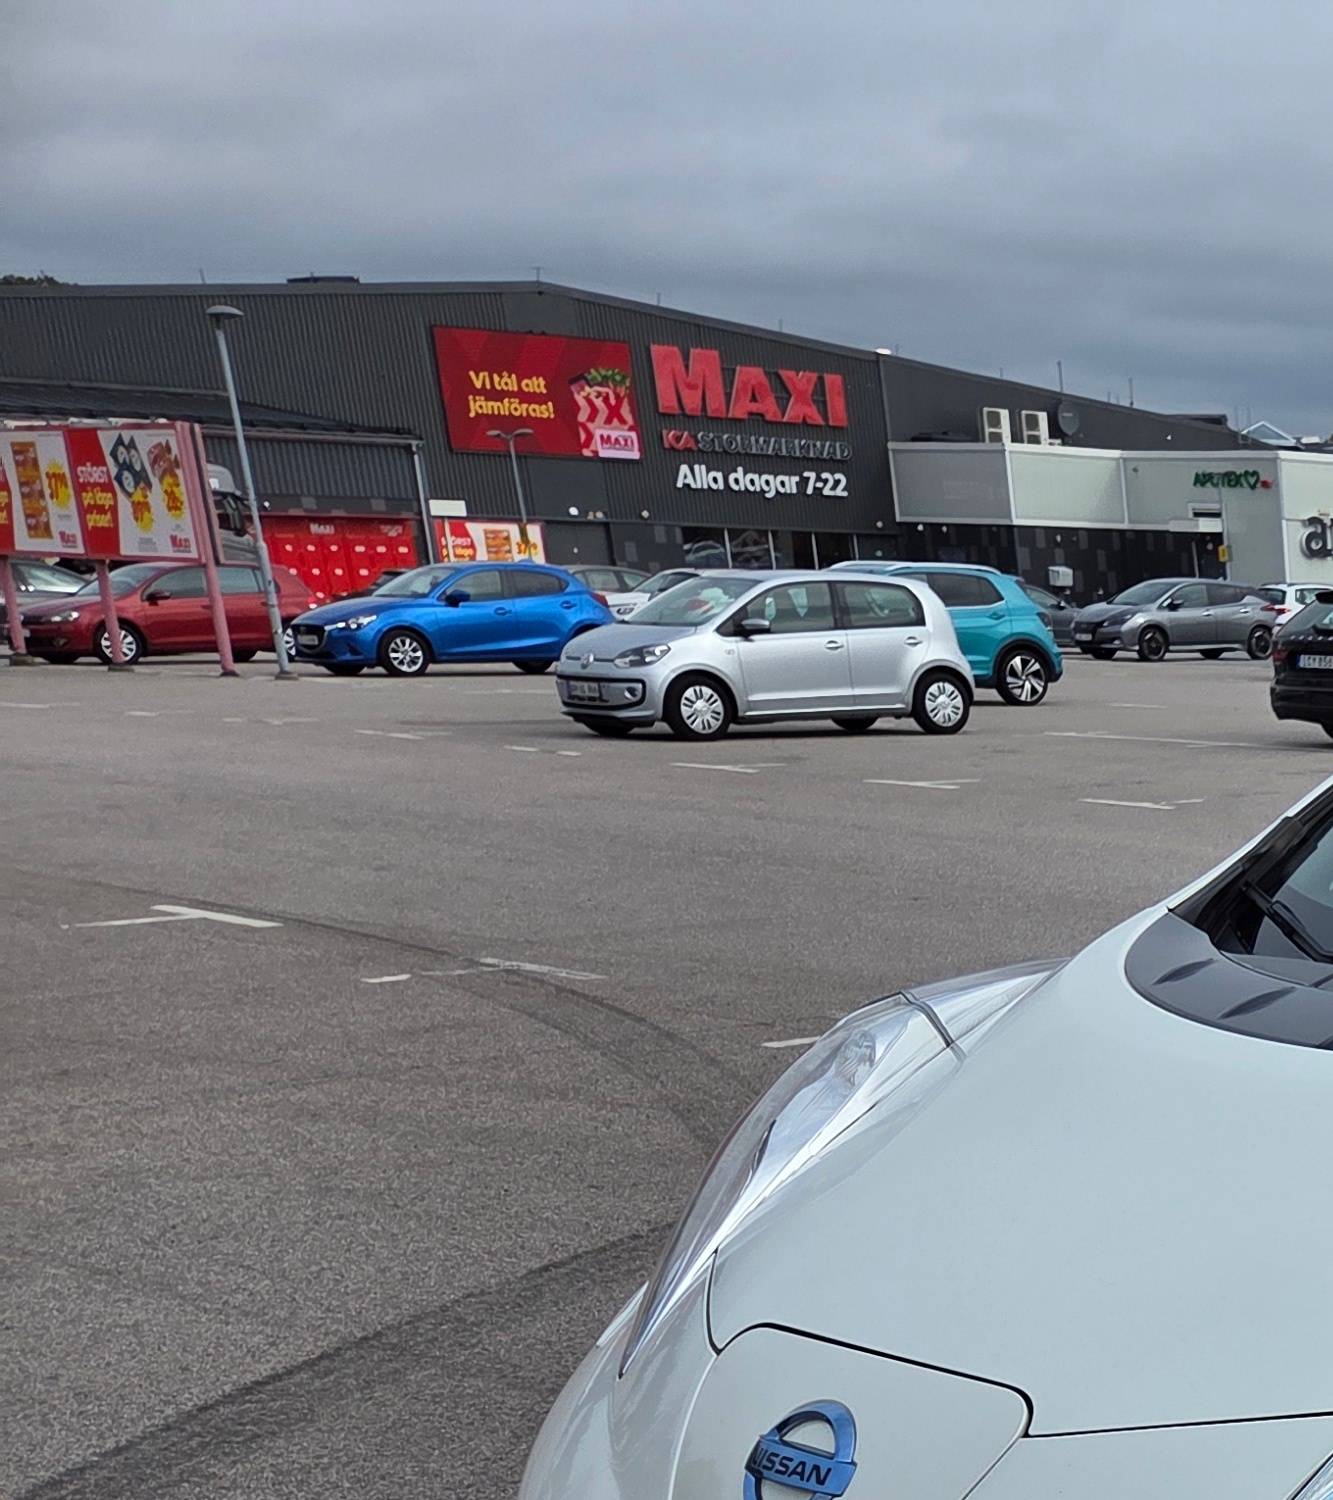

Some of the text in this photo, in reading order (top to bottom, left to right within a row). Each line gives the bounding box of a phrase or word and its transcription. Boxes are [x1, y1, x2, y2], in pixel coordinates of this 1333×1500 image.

[469, 370, 547, 394] Vi tål att
[651, 344, 848, 427] MAXI
[468, 395, 555, 419] jämföras!
[600, 433, 634, 449] MAXI
[663, 429, 852, 460] ICA STORMARKNAD
[676, 464, 848, 498] Alla dagar 7-22
[751, 1446, 832, 1486] NISSAN
